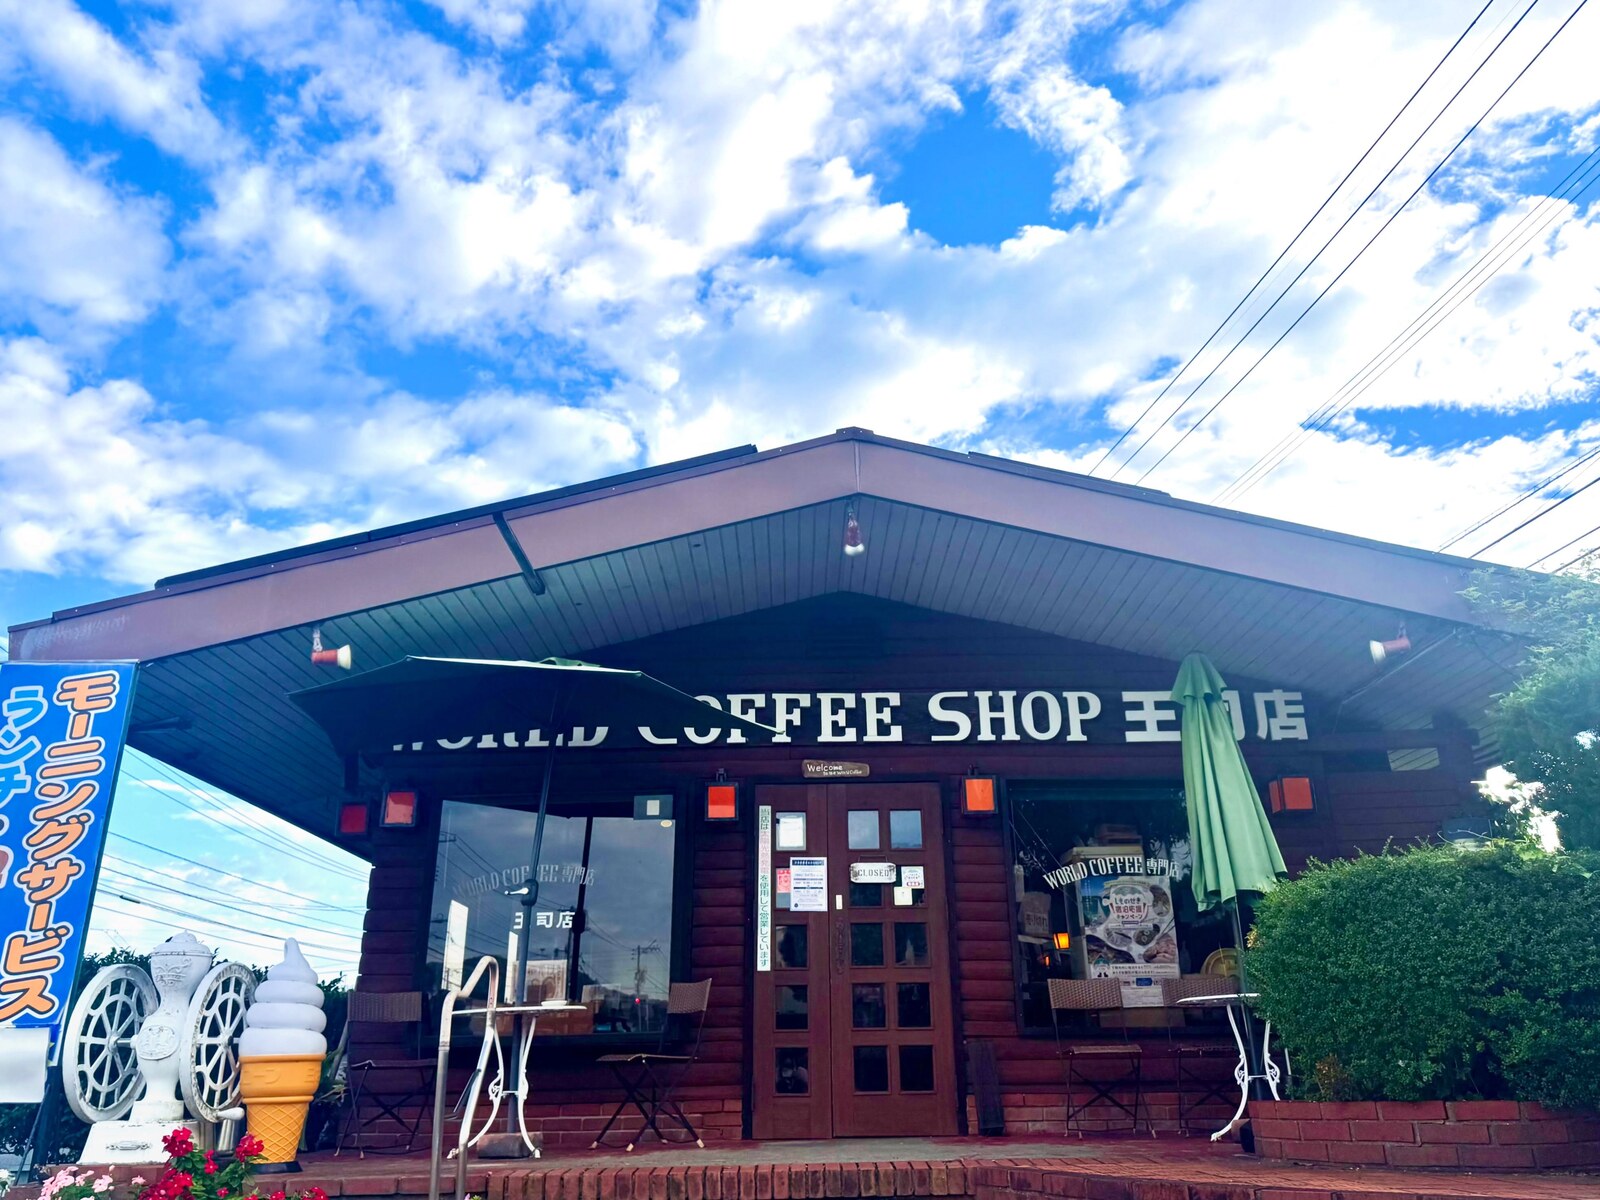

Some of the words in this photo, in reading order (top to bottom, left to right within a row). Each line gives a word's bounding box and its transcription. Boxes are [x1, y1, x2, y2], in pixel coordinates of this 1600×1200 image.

[927, 690, 1101, 742] SHOP
[806, 763, 843, 772] Welcome
[0, 671, 119, 1022] モーニングサービス
[452, 872, 500, 897] WORLD
[502, 864, 559, 887] COFEE
[857, 869, 889, 877] CLOSED
[1042, 861, 1088, 890] WORLD
[1088, 856, 1144, 876] COFFEE
[1146, 858, 1180, 880] 専門店
